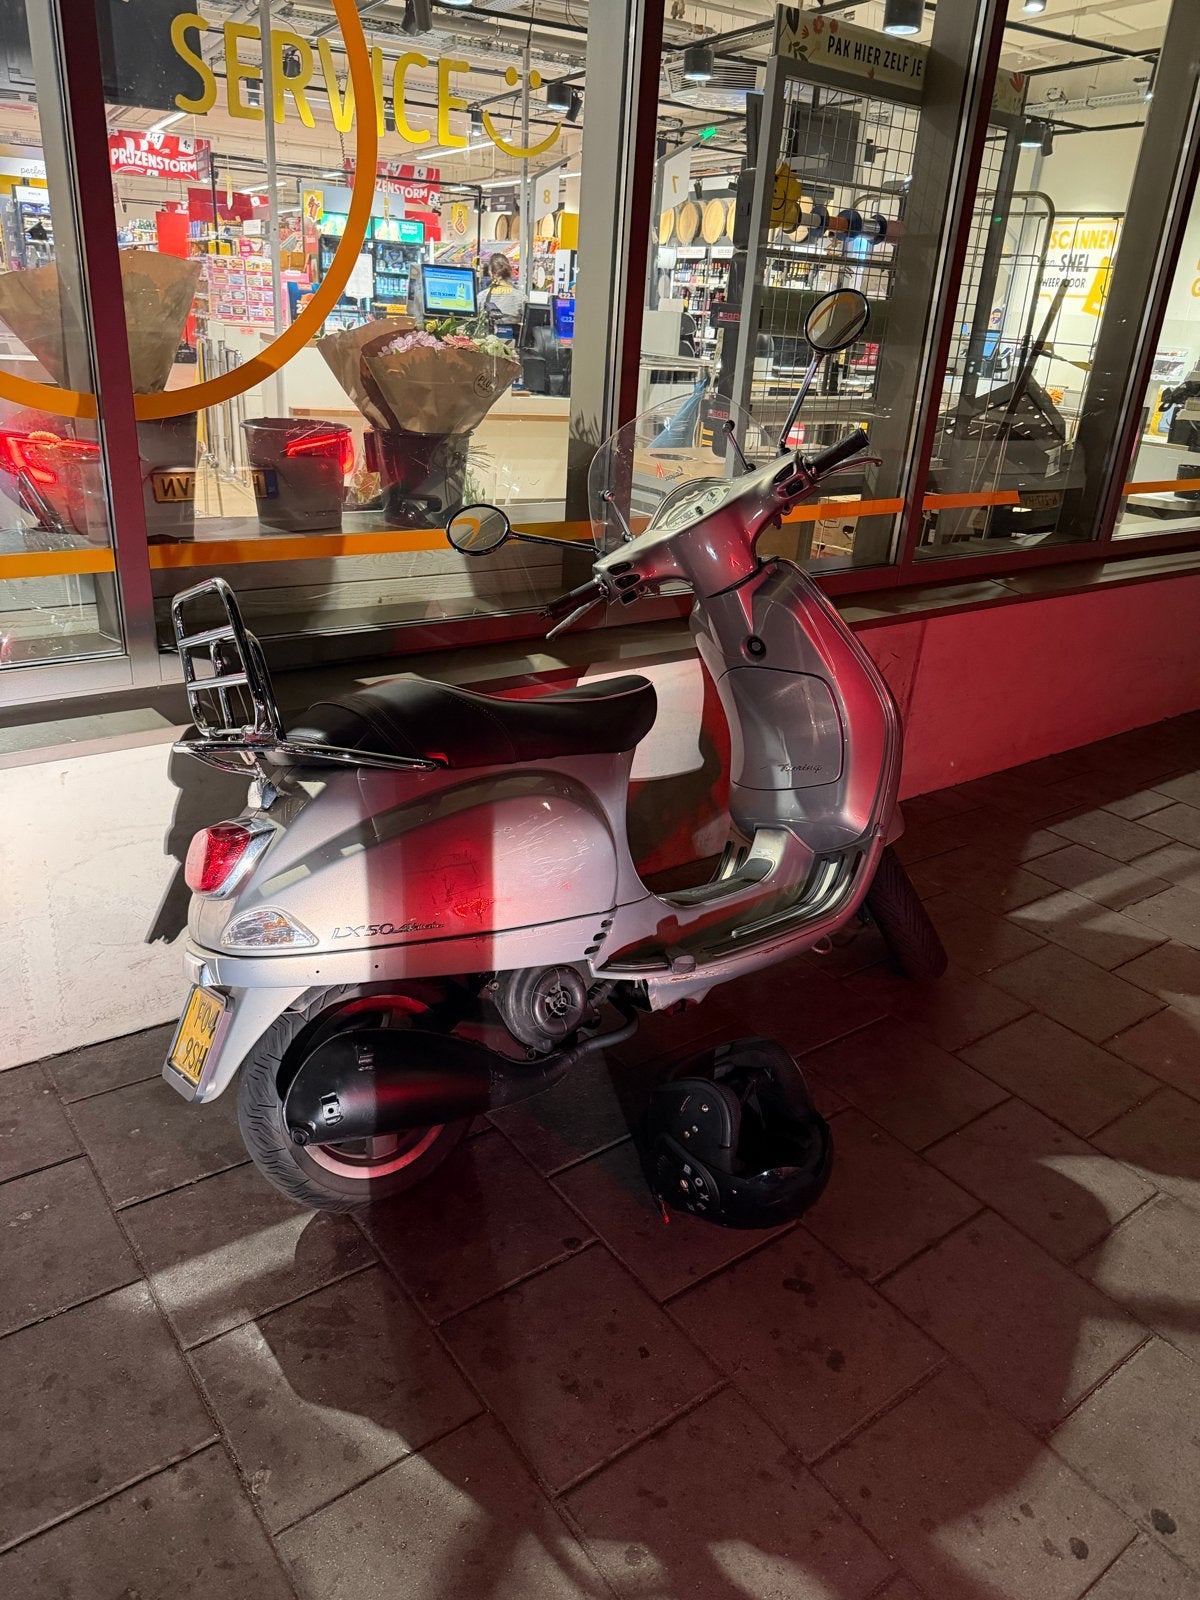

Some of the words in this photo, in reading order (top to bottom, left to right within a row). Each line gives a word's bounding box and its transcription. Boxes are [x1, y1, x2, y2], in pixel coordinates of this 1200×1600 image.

[828, 35, 851, 58] PAK
[854, 42, 881, 66] HIER
[883, 50, 909, 73] ZELF
[910, 58, 923, 77] JE
[171, 14, 471, 147] SERVICE
[543, 189, 551, 204] 8
[1059, 253, 1089, 272] SNEL
[183, 1036, 208, 1076] 9SH
